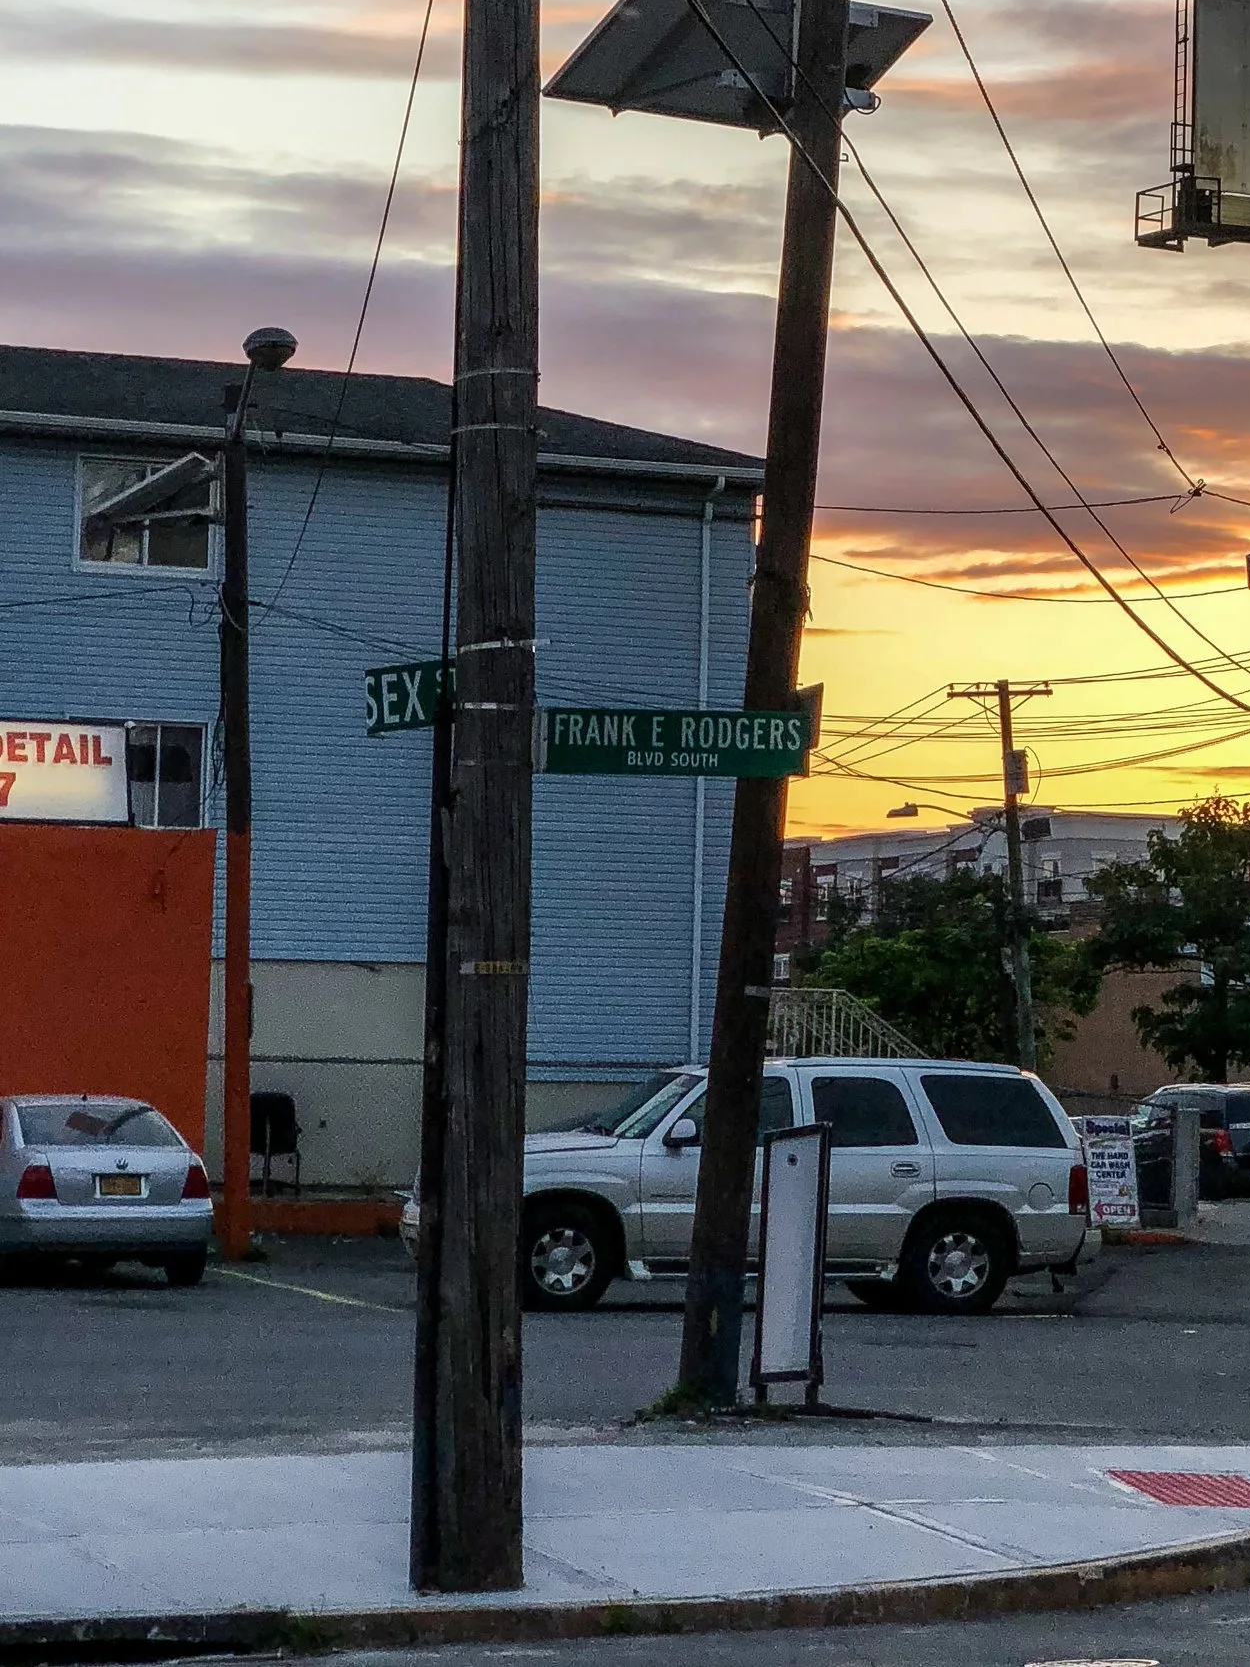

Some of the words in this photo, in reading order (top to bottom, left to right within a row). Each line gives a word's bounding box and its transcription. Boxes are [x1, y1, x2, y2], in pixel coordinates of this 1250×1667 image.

[365, 670, 425, 726] SEX
[554, 714, 637, 746] FRANK
[652, 715, 665, 746] E
[681, 717, 800, 751] RODGERS
[0, 731, 112, 766] ETAIL
[627, 750, 664, 766] BLVD
[670, 752, 718, 767] SOUTH
[1091, 1152, 1105, 1160] THE
[1107, 1152, 1128, 1160] HAND
[1090, 1161, 1106, 1169] CAR
[1108, 1161, 1130, 1169] WASH
[1096, 1171, 1126, 1179] CENTER
[1103, 1205, 1130, 1214] OPEN
